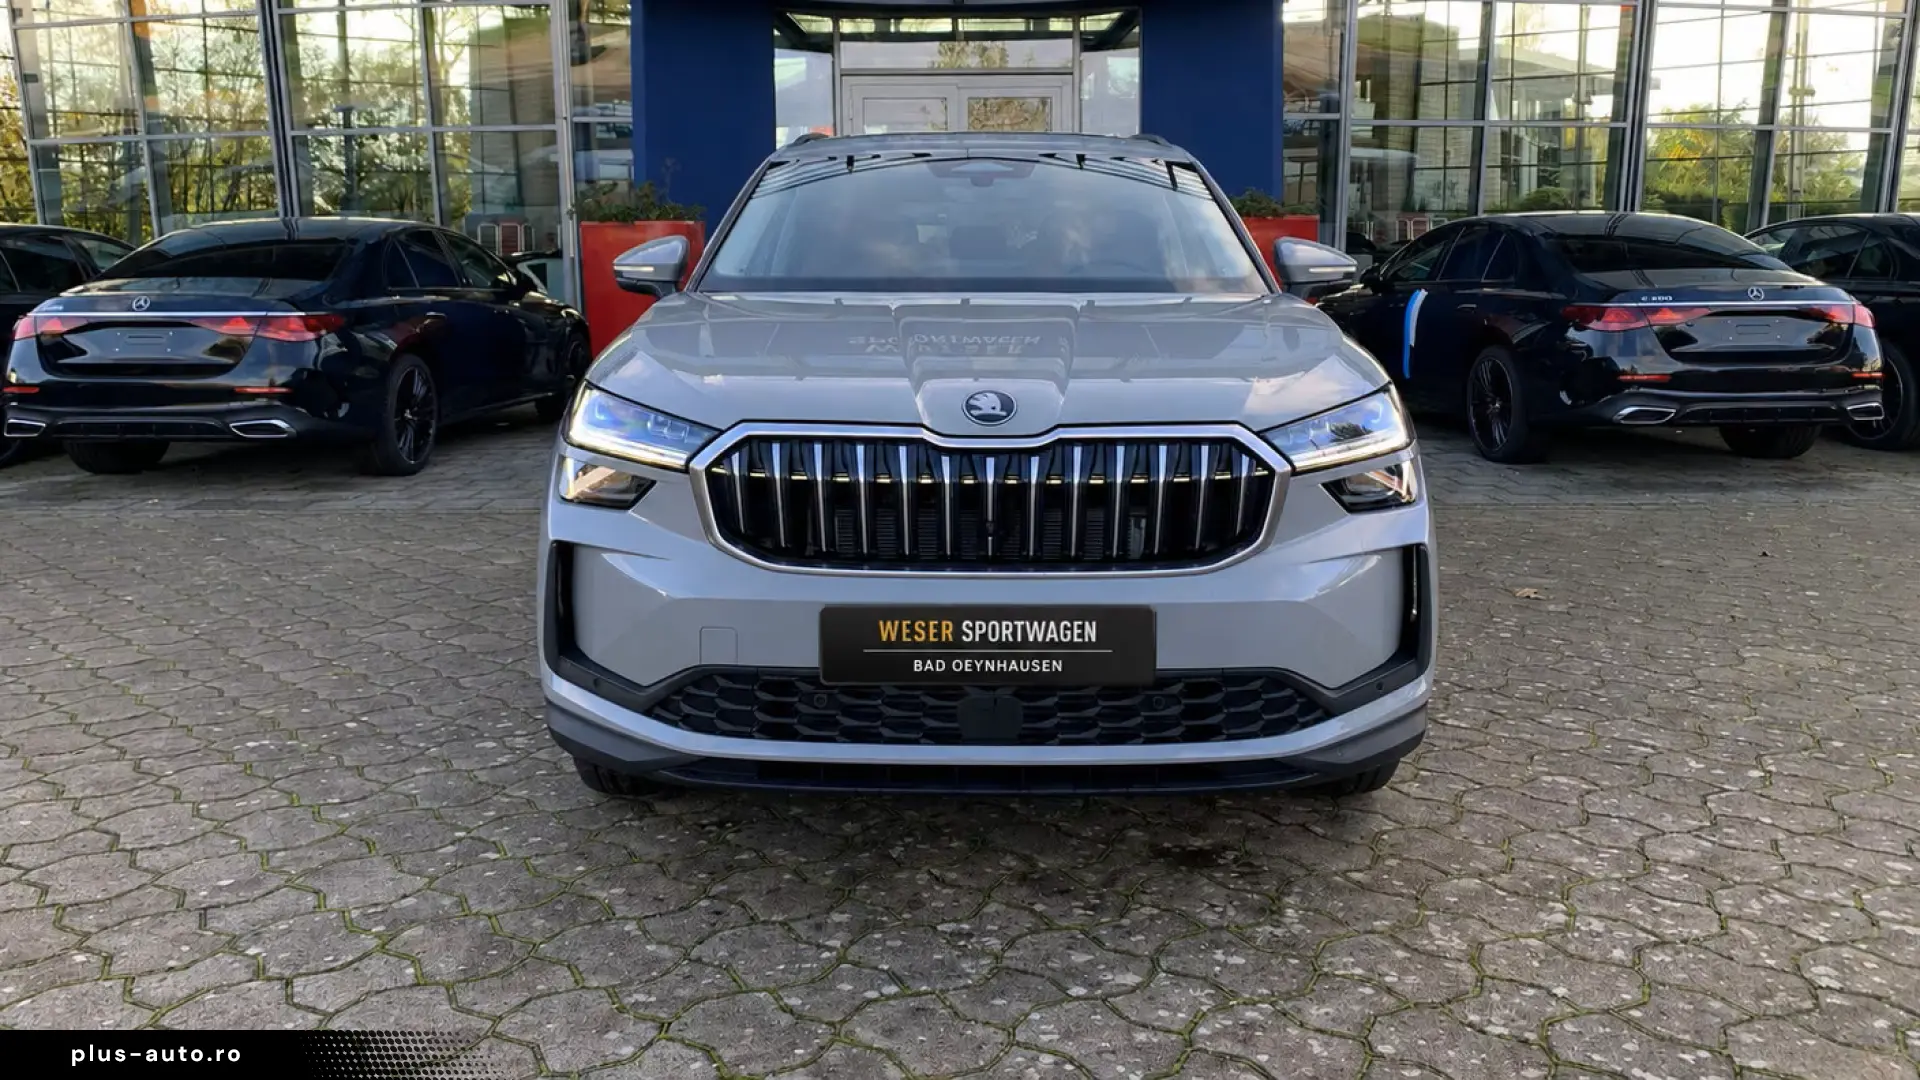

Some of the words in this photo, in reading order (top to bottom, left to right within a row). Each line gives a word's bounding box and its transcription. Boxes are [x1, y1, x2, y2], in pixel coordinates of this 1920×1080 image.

[878, 619, 953, 643] WESER
[961, 619, 1097, 643] SPORTWAGEN
[913, 659, 945, 672] BAD
[951, 659, 1063, 672] OEYNHAUSEN
